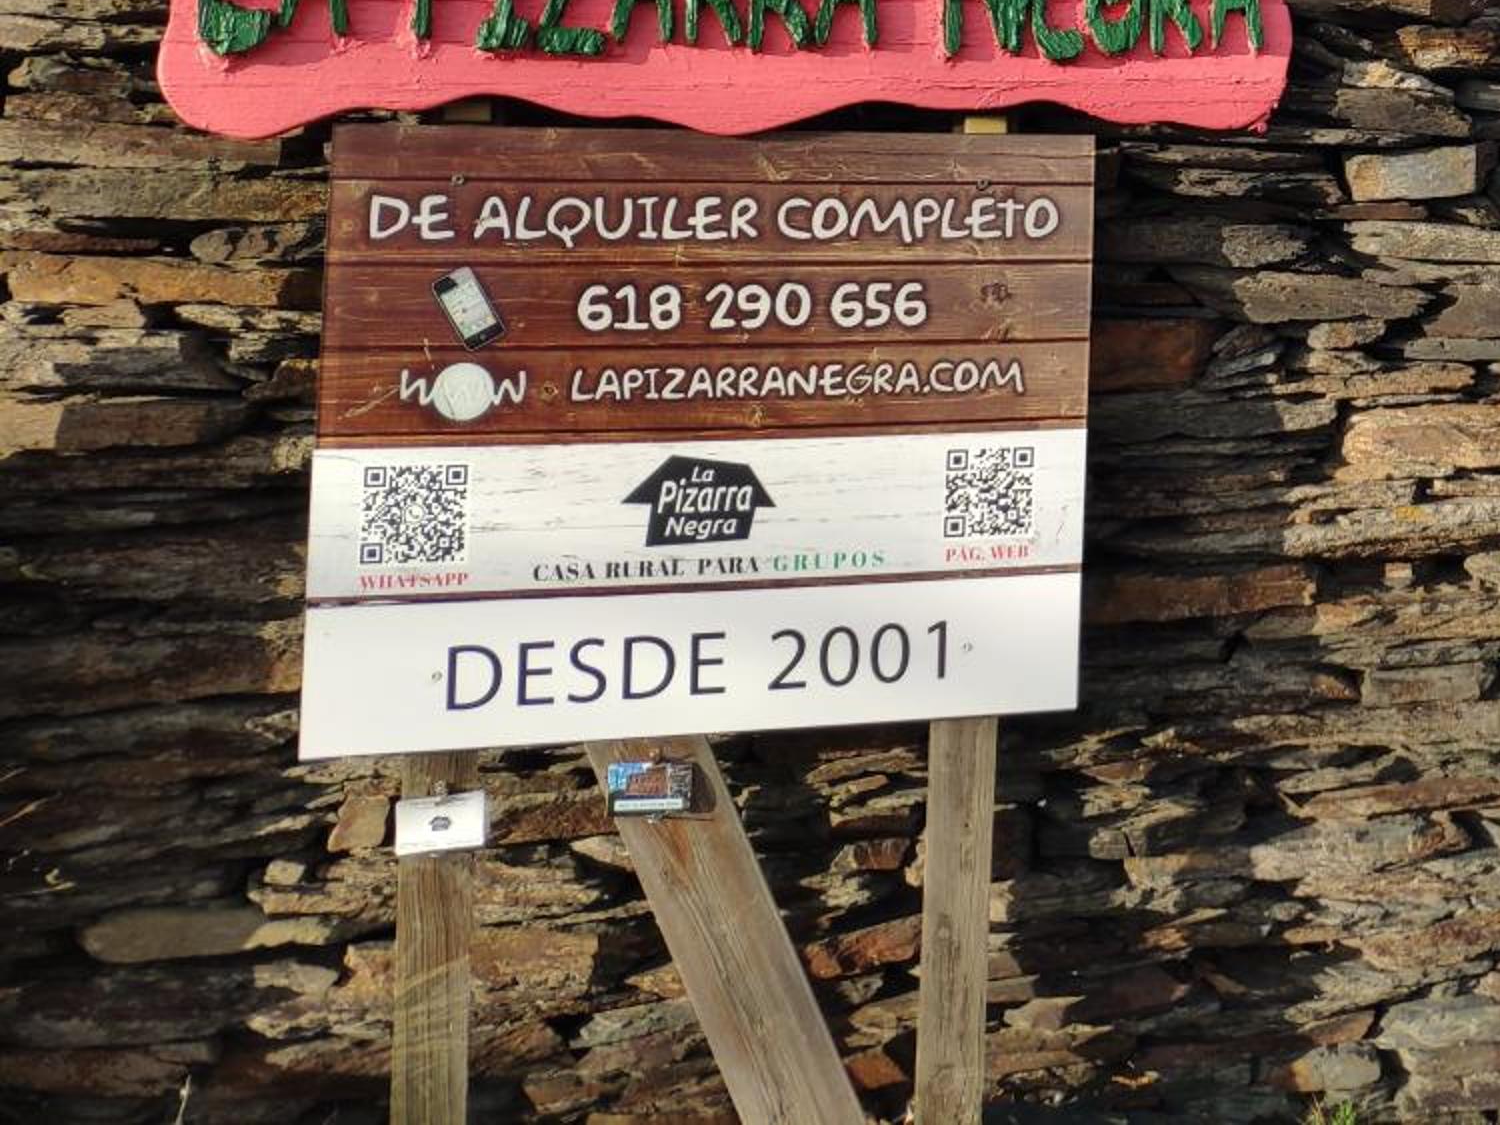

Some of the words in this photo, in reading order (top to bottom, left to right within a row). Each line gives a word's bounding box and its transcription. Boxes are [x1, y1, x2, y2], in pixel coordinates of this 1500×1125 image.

[369, 194, 454, 240] DE
[473, 195, 758, 248] ALQUILER
[777, 197, 1060, 243] COMPLETO
[577, 284, 681, 331] 618
[705, 282, 812, 330] 290
[830, 282, 928, 328] 656
[571, 361, 1025, 401] LAPIZARRANEGRA.COM
[691, 466, 714, 483] La
[657, 478, 752, 514] Pizarra
[664, 516, 737, 540] Negra
[533, 562, 596, 582] CASA
[606, 559, 684, 579] RURAL
[697, 556, 759, 575] PARA
[772, 551, 886, 572] GRUPOS
[991, 544, 1029, 559] WEB
[358, 572, 469, 591] WHATSAPP
[445, 631, 727, 711] DESDE
[767, 620, 949, 691] 2001
